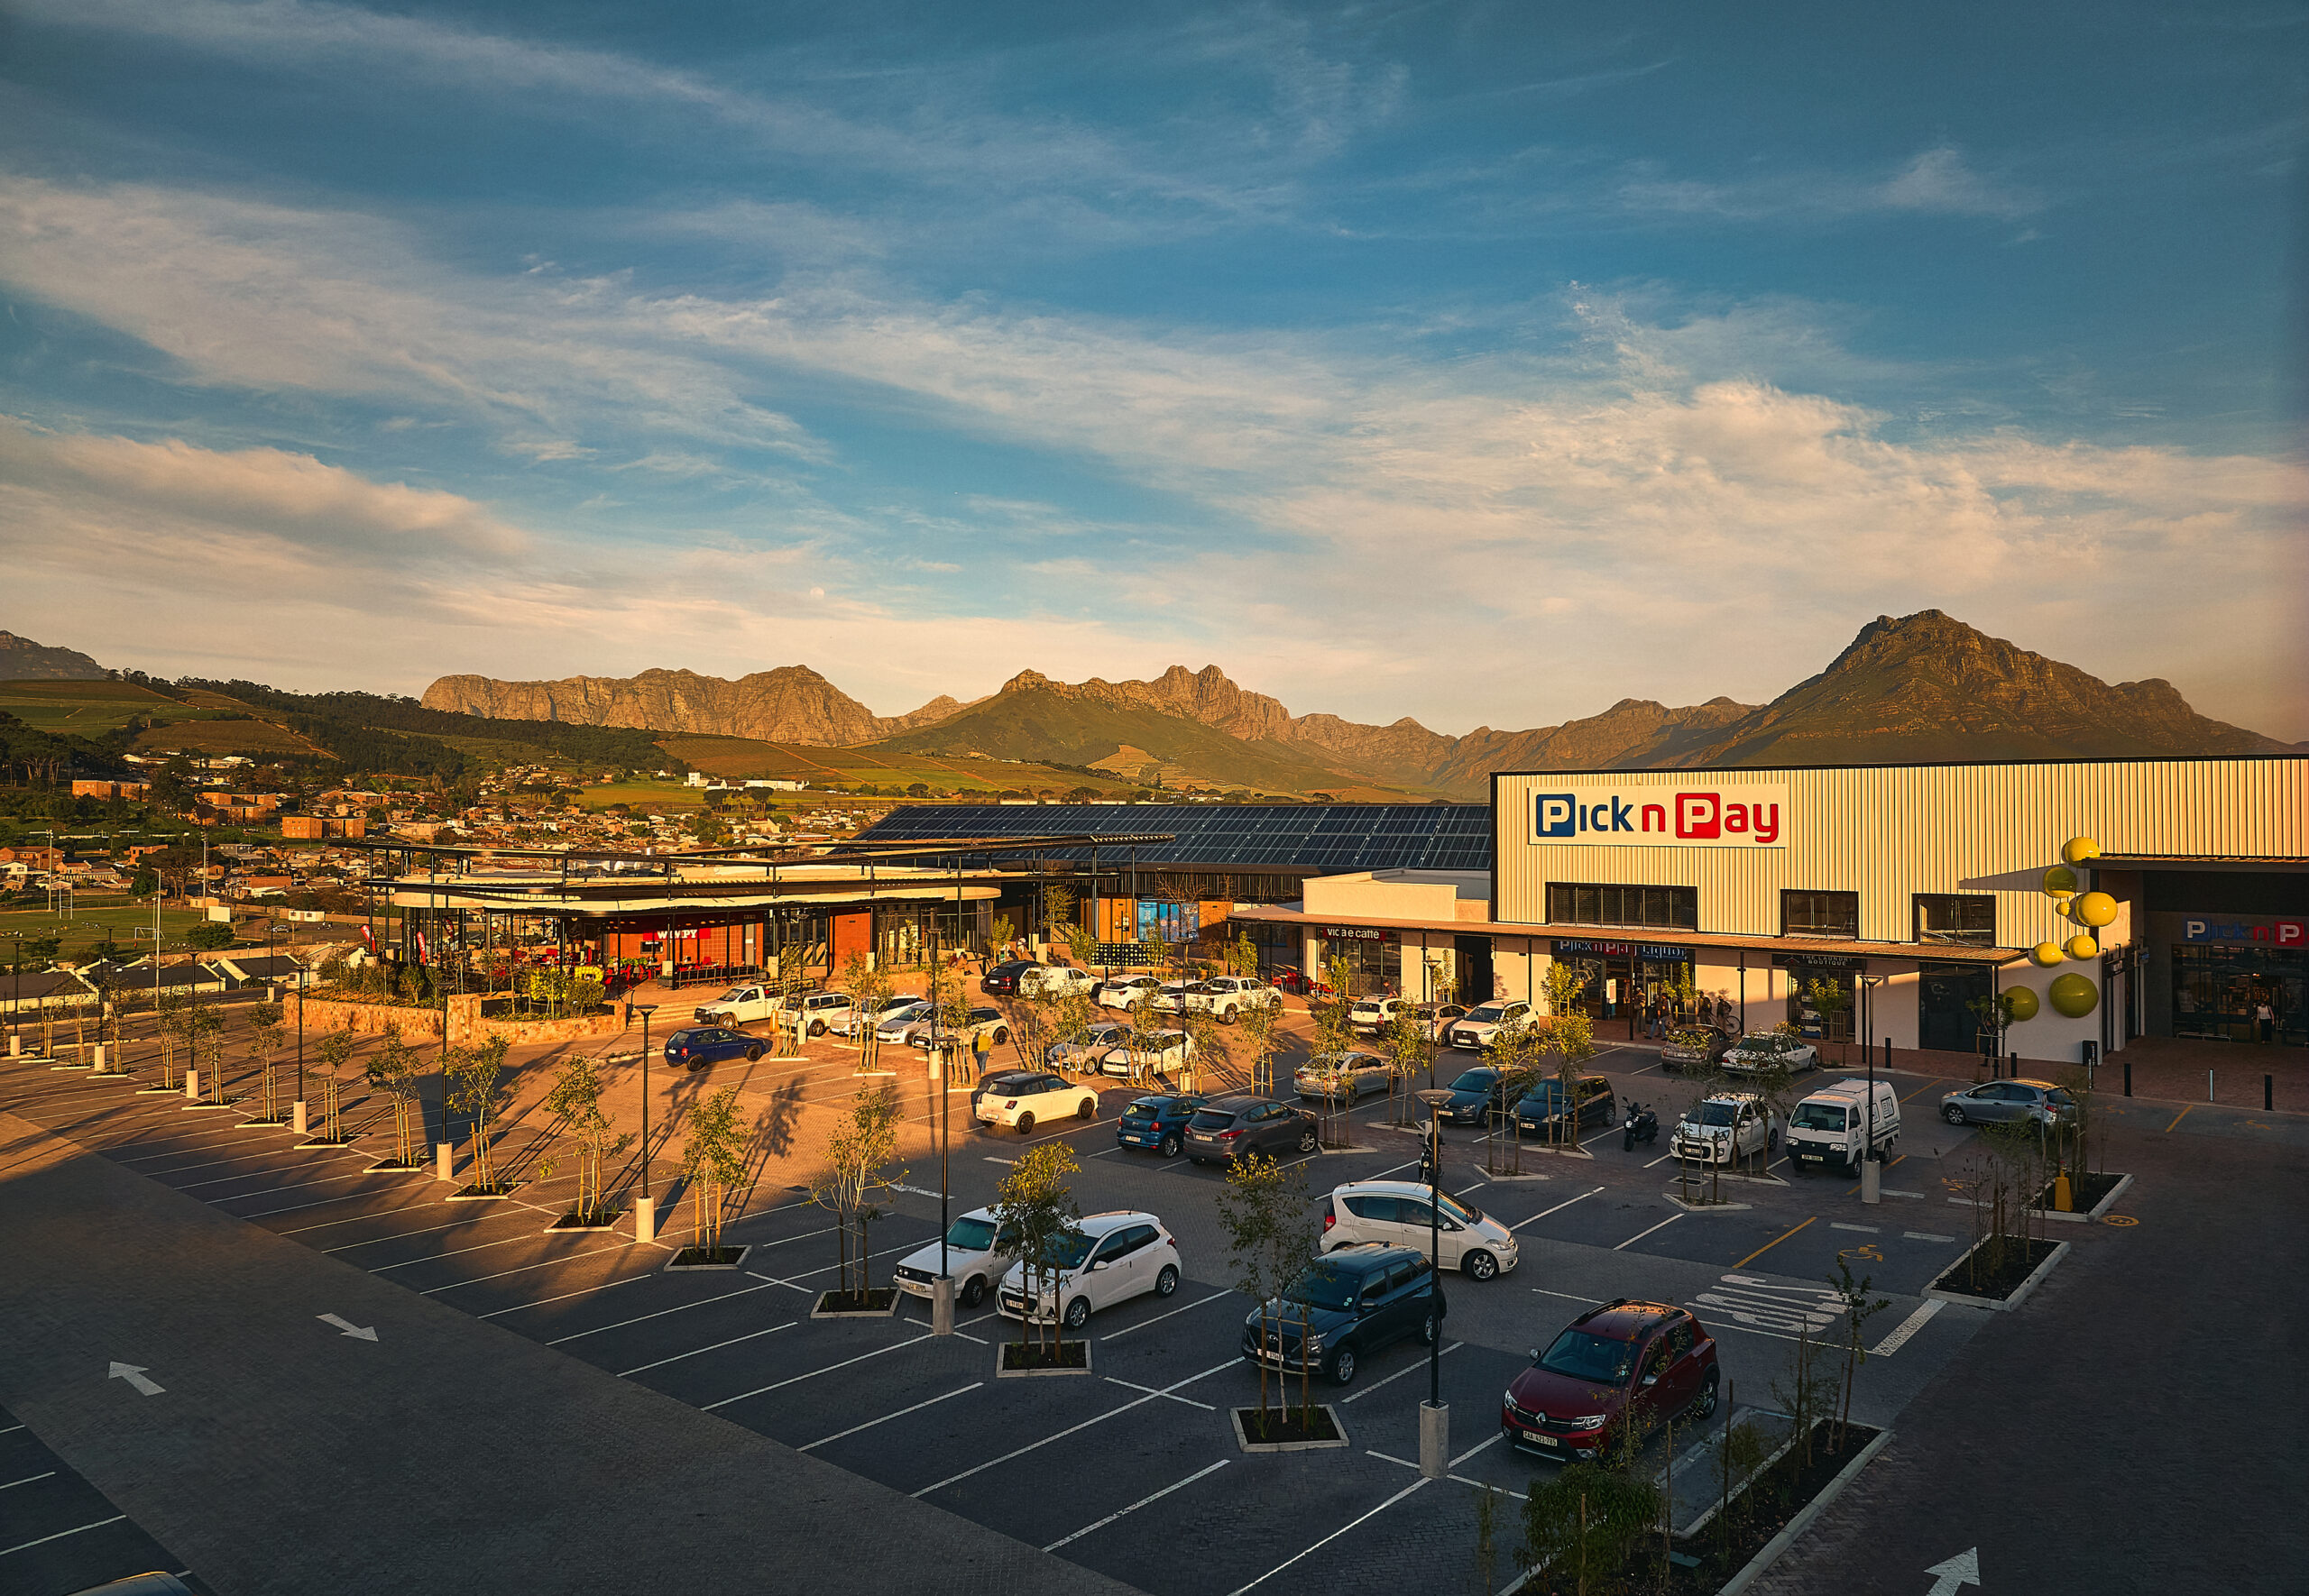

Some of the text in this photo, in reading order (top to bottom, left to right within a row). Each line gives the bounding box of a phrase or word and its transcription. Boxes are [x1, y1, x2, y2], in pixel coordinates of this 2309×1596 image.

[1536, 793, 1779, 843] Pick n Pay
[657, 930, 698, 940] WIMPY
[2184, 918, 2309, 946] Pick n P
[1808, 959, 1846, 967] BOUTIQUE
